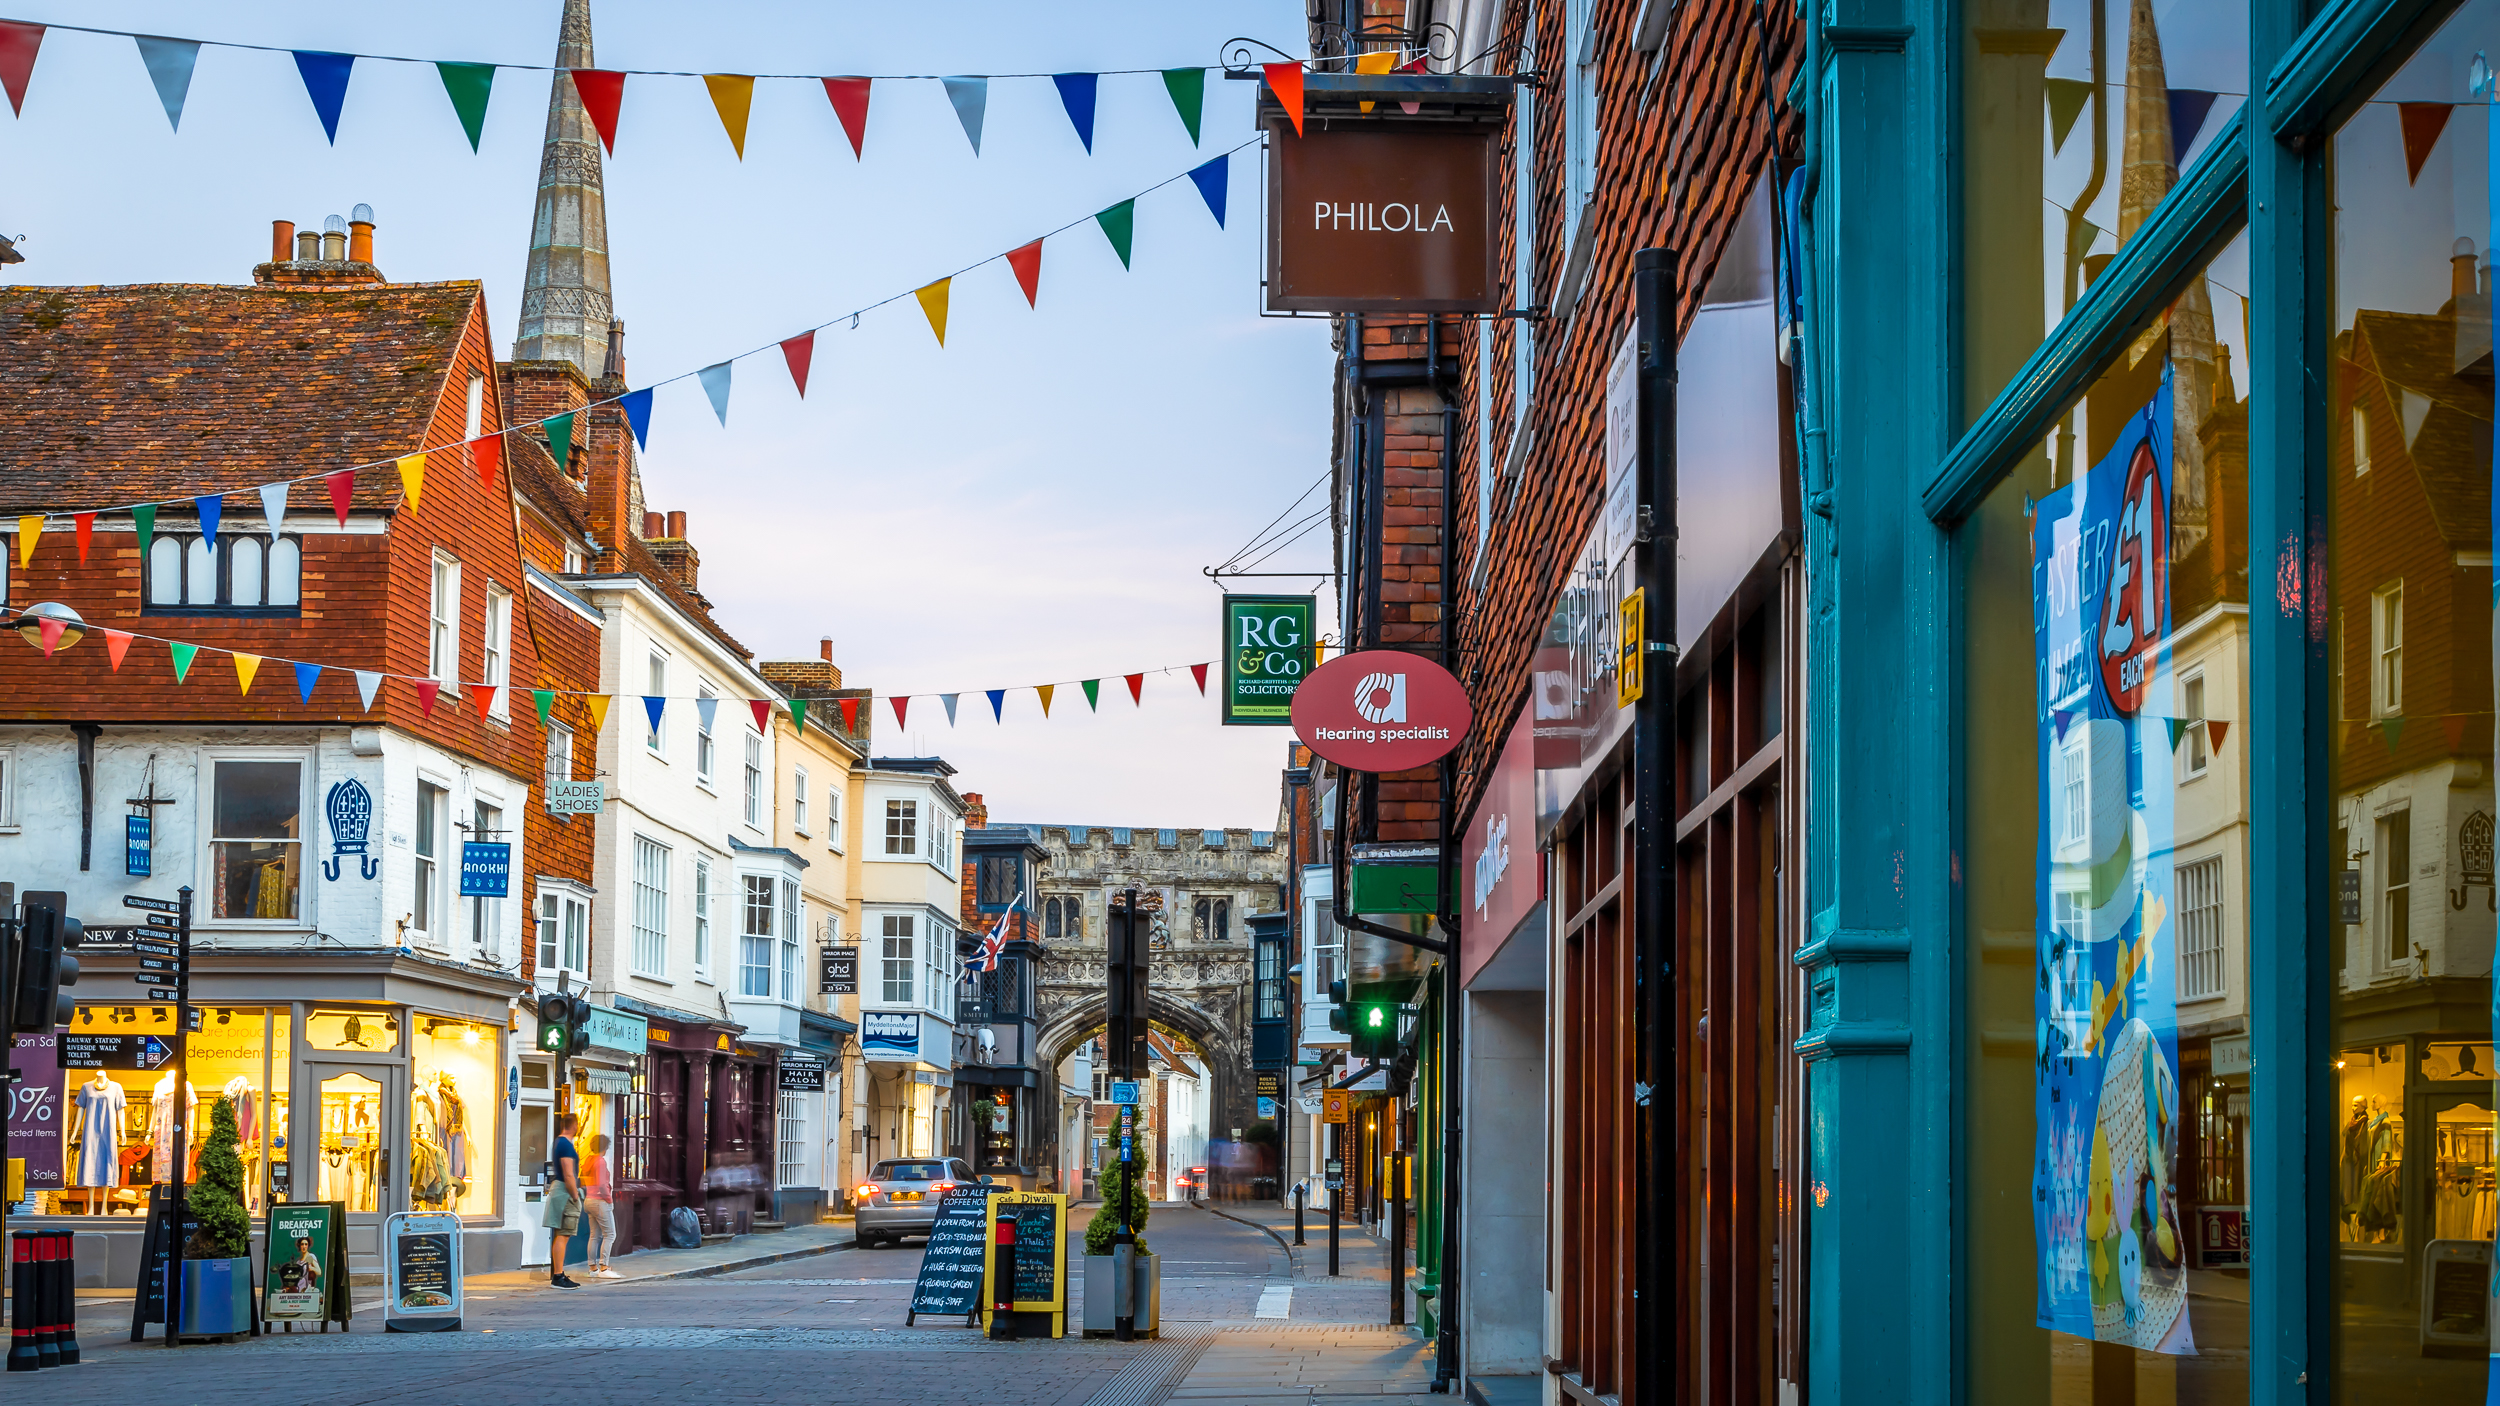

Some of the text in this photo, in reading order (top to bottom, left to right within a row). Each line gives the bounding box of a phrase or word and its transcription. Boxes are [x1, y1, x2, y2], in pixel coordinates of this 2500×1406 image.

[1315, 201, 1454, 232] PHILOLA
[2103, 473, 2156, 658] £1
[2033, 518, 2110, 634] EASTER
[1238, 615, 1301, 647] RG
[2120, 650, 2145, 693] EACH
[1315, 726, 1450, 743] Hearing specialist
[555, 785, 600, 798] LADIES
[555, 799, 599, 811] SHOES
[128, 838, 150, 850] ANOKHI
[464, 862, 508, 875] ANOKHI
[83, 930, 116, 941] NEW
[827, 962, 850, 978] ghd
[201, 1027, 224, 1038] are
[16, 1036, 57, 1048] son Sal
[66, 1036, 92, 1044] RAILWAY
[66, 1044, 97, 1052] RIVERSIDE
[187, 1045, 264, 1060] dependent
[785, 1076, 818, 1084] SALON
[7, 1086, 56, 1123] 0% off
[1303, 1098, 1323, 1107] CAS
[7, 1129, 57, 1137] ected Items
[33, 1169, 58, 1180] Sale
[951, 1189, 968, 1197] OLD
[969, 1189, 985, 1197] ALE
[1020, 1194, 1054, 1203] Diwali
[943, 1198, 971, 1206] COFFEE
[278, 1219, 323, 1230] BREAKFAST
[941, 1218, 958, 1226] OPEN
[958, 1219, 975, 1227] FROM
[1018, 1218, 1045, 1226] Lunches
[290, 1229, 309, 1238] CLUB
[937, 1232, 954, 1240] FOOD
[933, 1246, 984, 1256] ARTISAN COFFEE
[928, 1262, 984, 1273] HUGE GIN SELECTION
[924, 1277, 974, 1289] GLORIOUS GARDEN
[920, 1295, 964, 1307] SMILING STAFF
